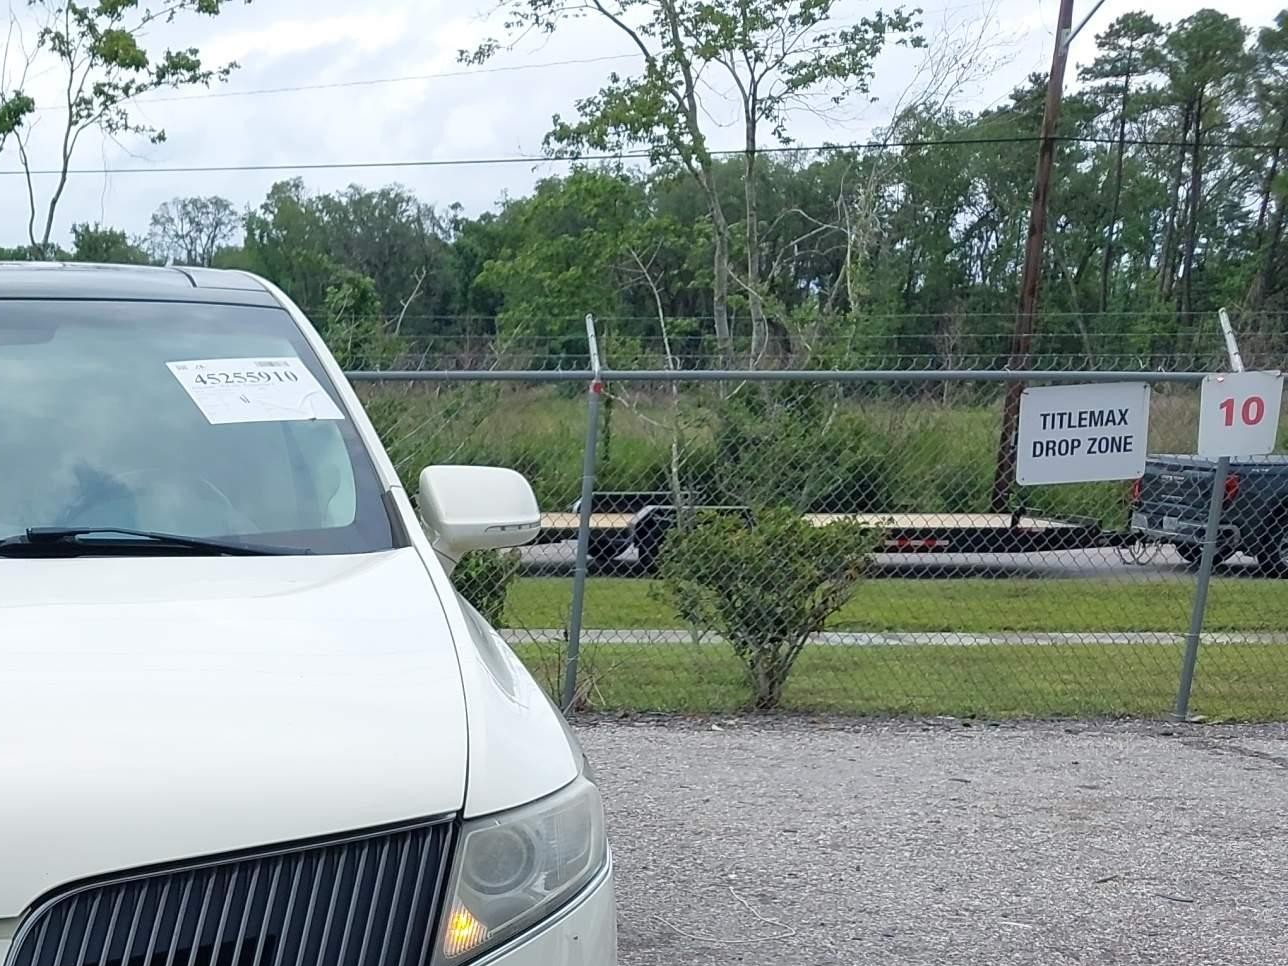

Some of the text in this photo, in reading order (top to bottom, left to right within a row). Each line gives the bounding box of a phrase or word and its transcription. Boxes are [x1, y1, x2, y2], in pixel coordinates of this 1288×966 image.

[194, 370, 299, 386] 45255910
[1039, 408, 1130, 431] TITLEMAX
[1219, 396, 1265, 427] 10
[1032, 435, 1134, 458] DROP ZONE
